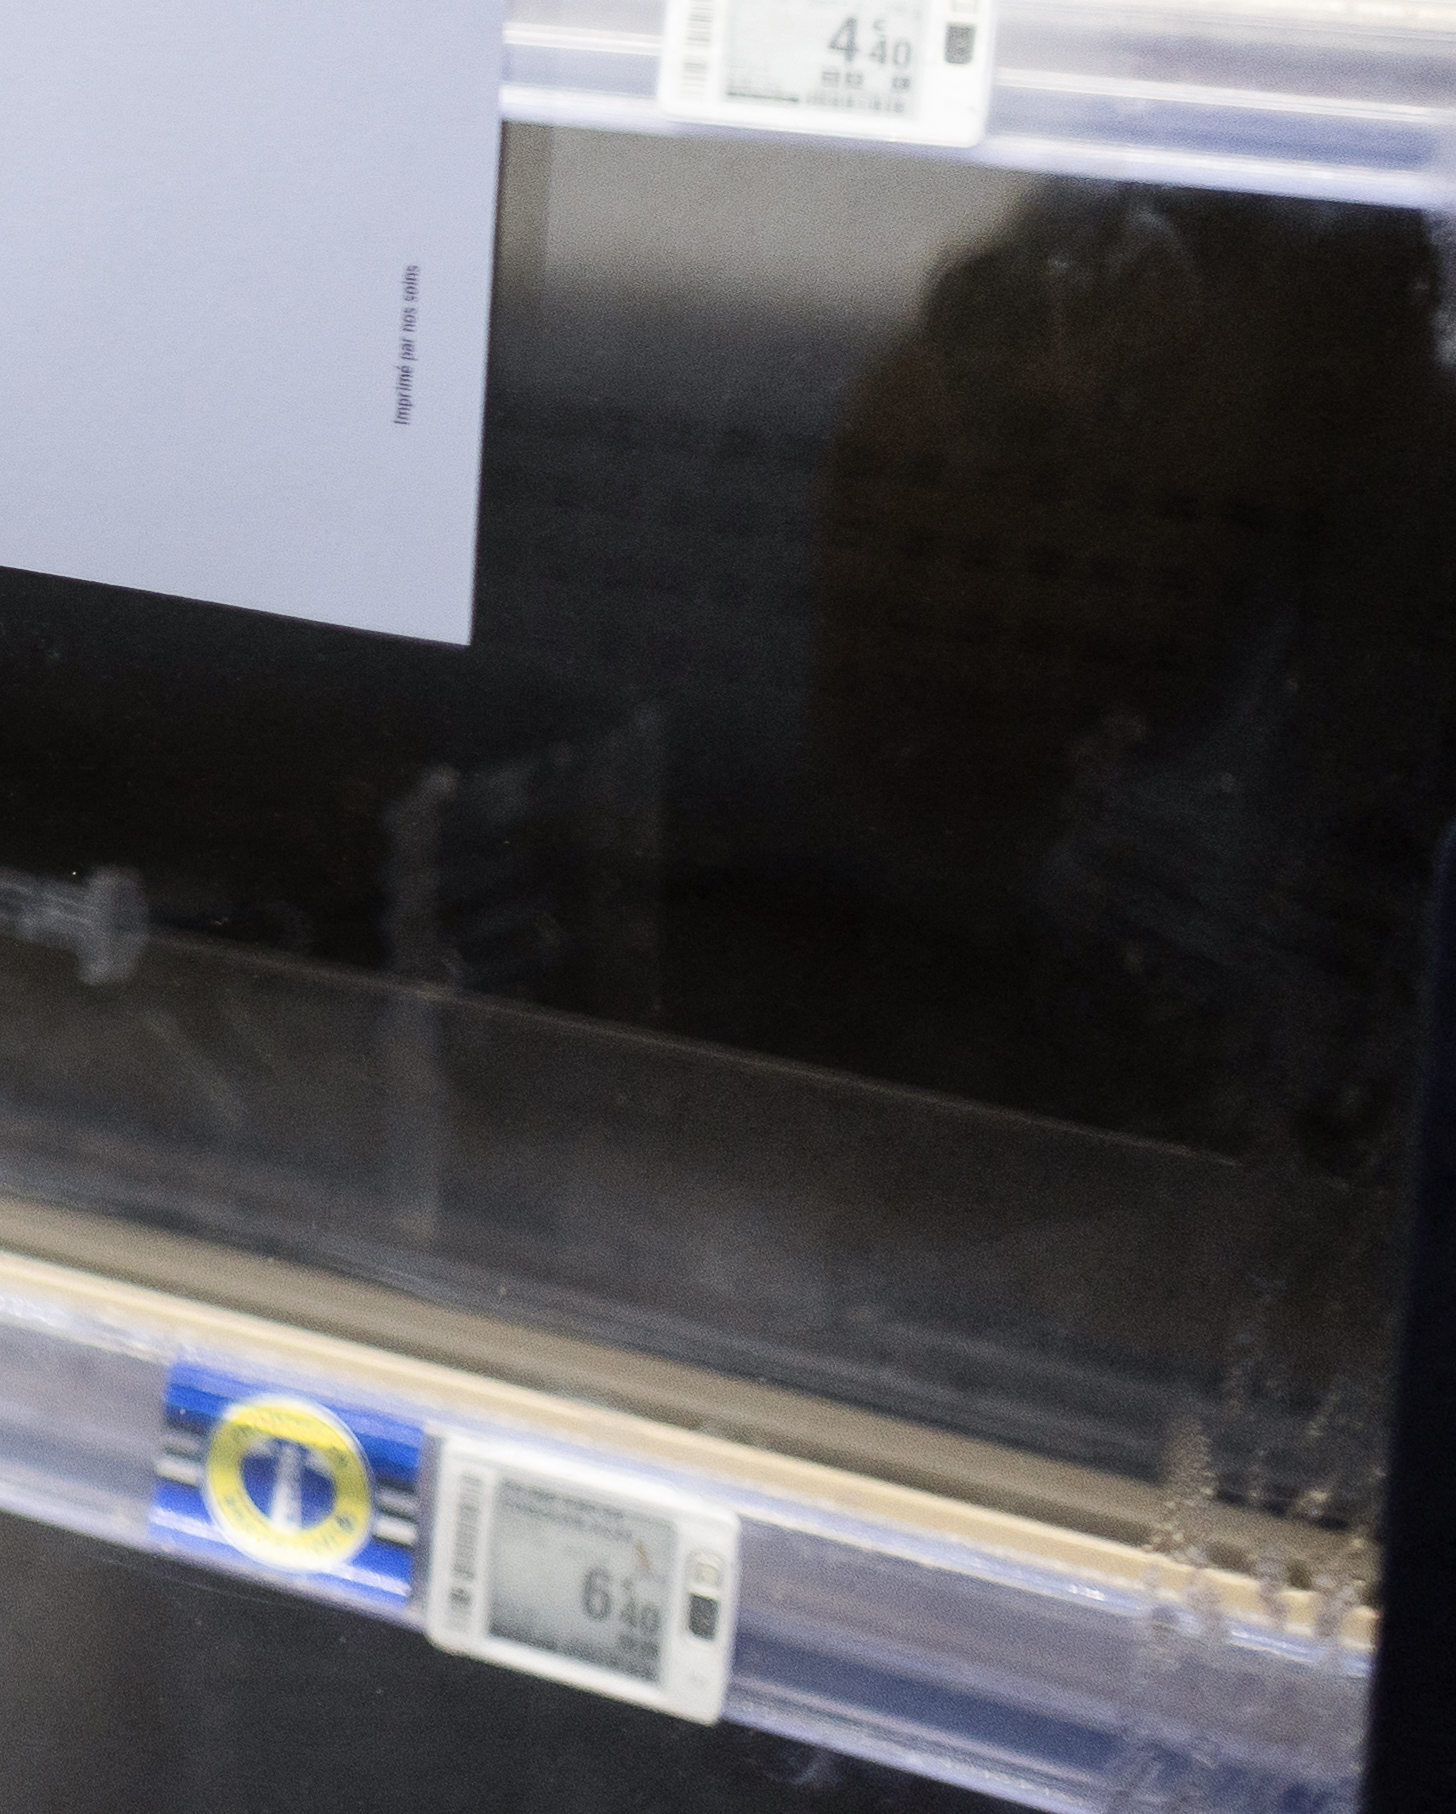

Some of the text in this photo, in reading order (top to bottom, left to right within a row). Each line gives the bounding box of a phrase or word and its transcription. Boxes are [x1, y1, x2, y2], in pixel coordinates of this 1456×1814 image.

[393, 264, 421, 426] Imprimé par nos soins
